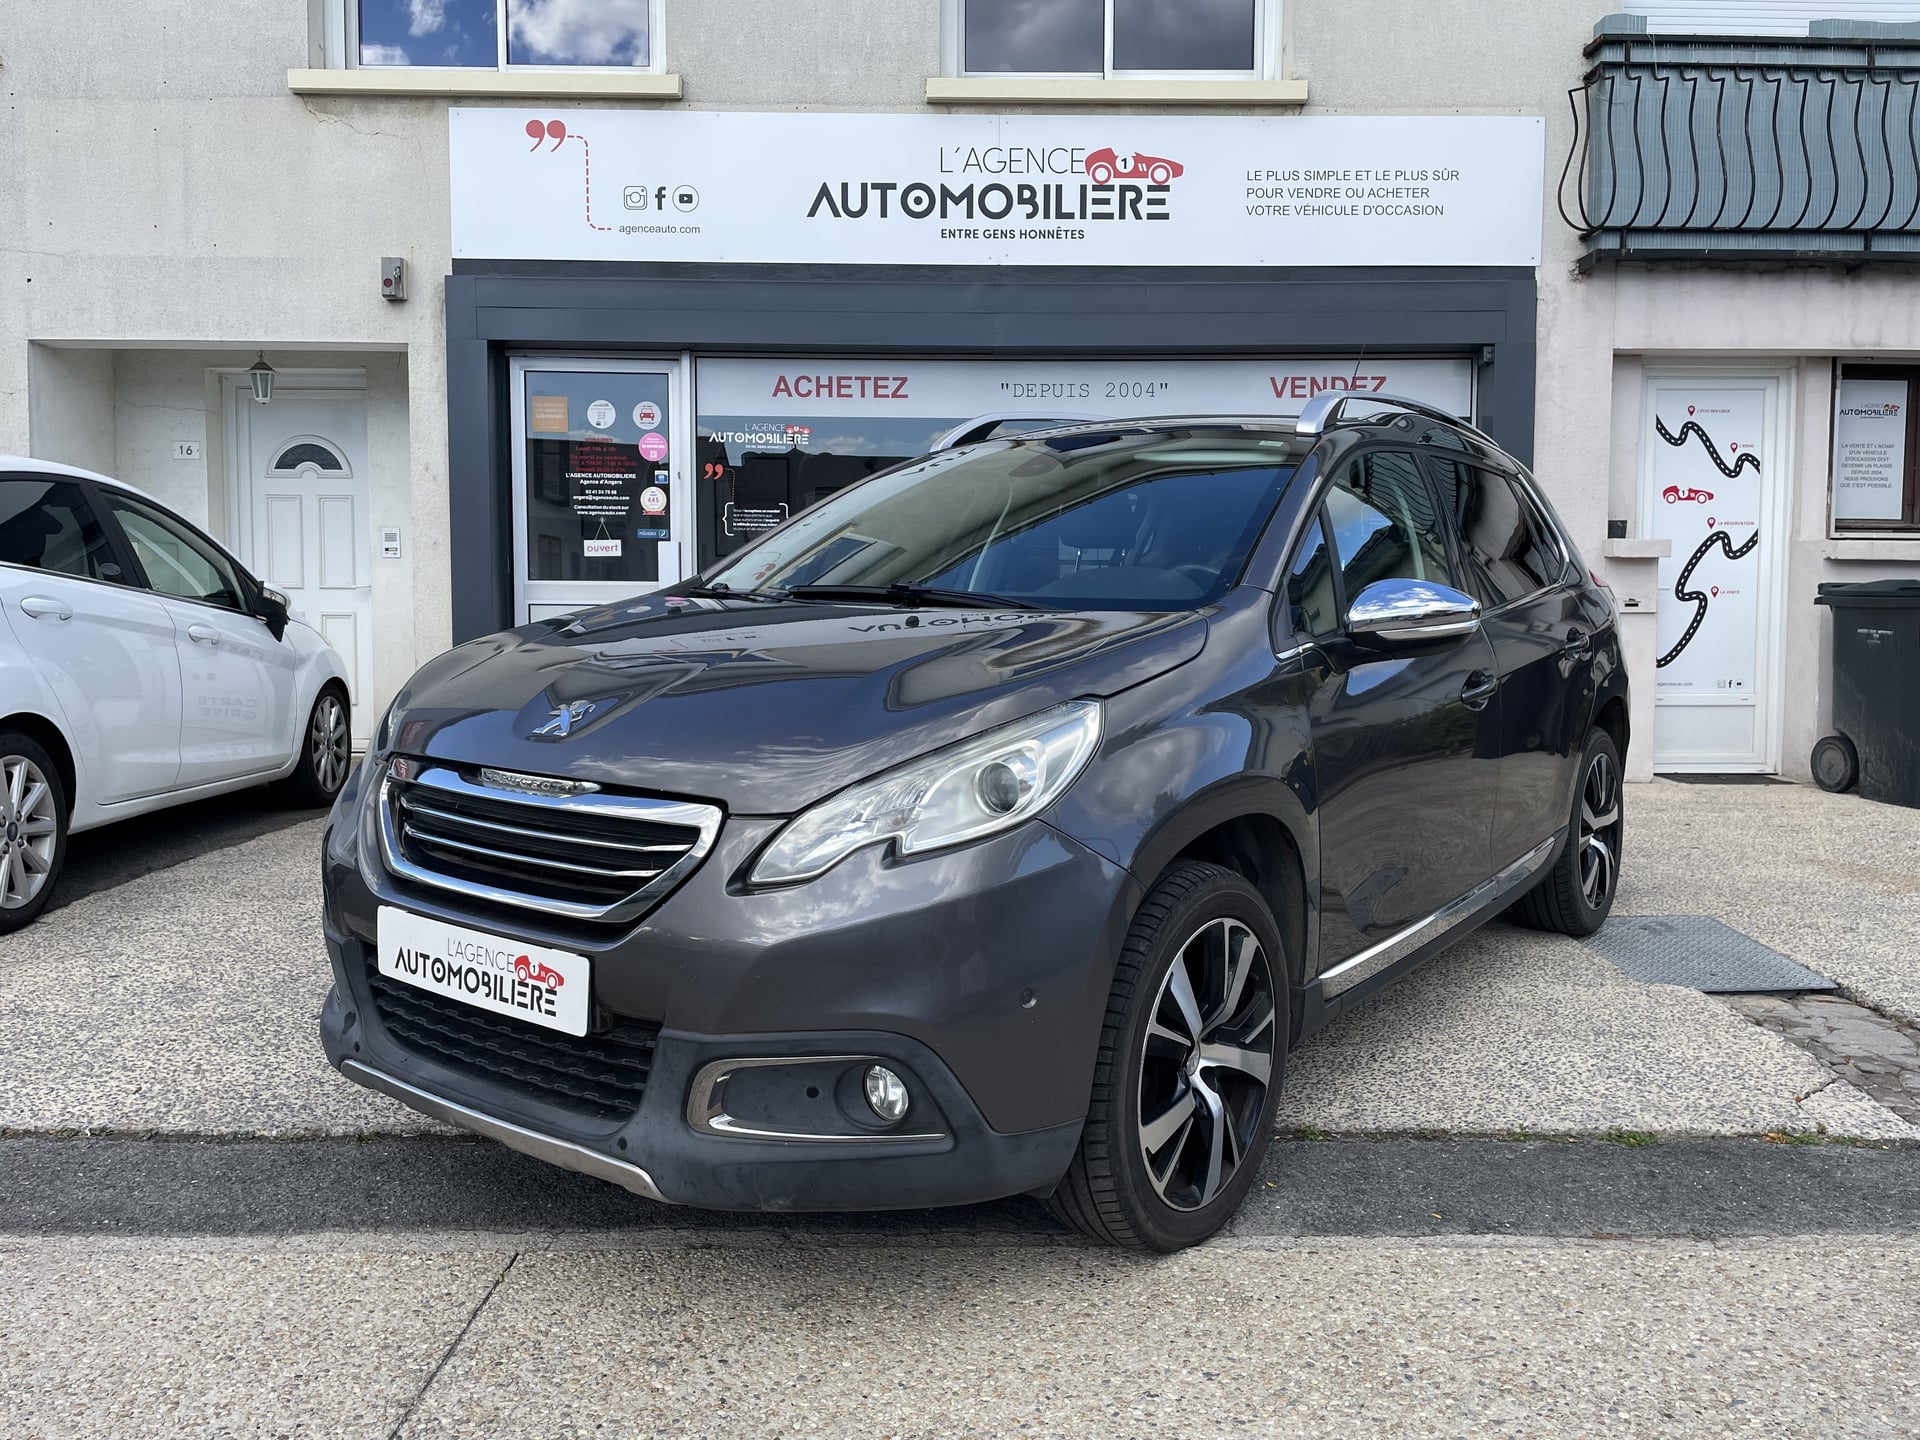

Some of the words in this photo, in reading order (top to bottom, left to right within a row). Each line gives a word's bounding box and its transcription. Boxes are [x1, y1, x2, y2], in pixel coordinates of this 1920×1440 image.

[940, 146, 1086, 174] L'AGENCE
[1246, 170, 1262, 181] LE
[1266, 170, 1300, 181] PLUS
[1303, 170, 1351, 181] SIMPLE
[1355, 170, 1371, 181] ET
[1375, 170, 1390, 181] LE
[1394, 170, 1428, 181] PLUS
[1432, 167, 1460, 181] SÛR
[1246, 187, 1283, 199] POUR
[1287, 187, 1341, 199] VENDRE
[1345, 187, 1365, 199] OU
[1367, 187, 1430, 199] ACHETER
[1246, 204, 1290, 216] VOTRE
[1294, 202, 1359, 216] VÉHICULE
[1363, 204, 1444, 216] D'OCCASION
[619, 225, 701, 235] agenceauto.com
[941, 229, 979, 240] ENTRE
[982, 229, 1016, 240] GENS
[1019, 226, 1085, 240] HONNÊTES
[772, 376, 909, 399] ACHETEZ
[1000, 381, 1090, 398] "DEPUIS
[1105, 381, 1169, 398] 2004"
[1269, 376, 1387, 398] VENDEZ
[745, 423, 785, 431] L'AGENCE
[180, 445, 193, 455] 16
[587, 544, 618, 552] ouvert
[447, 937, 515, 974] L'AGENCE
